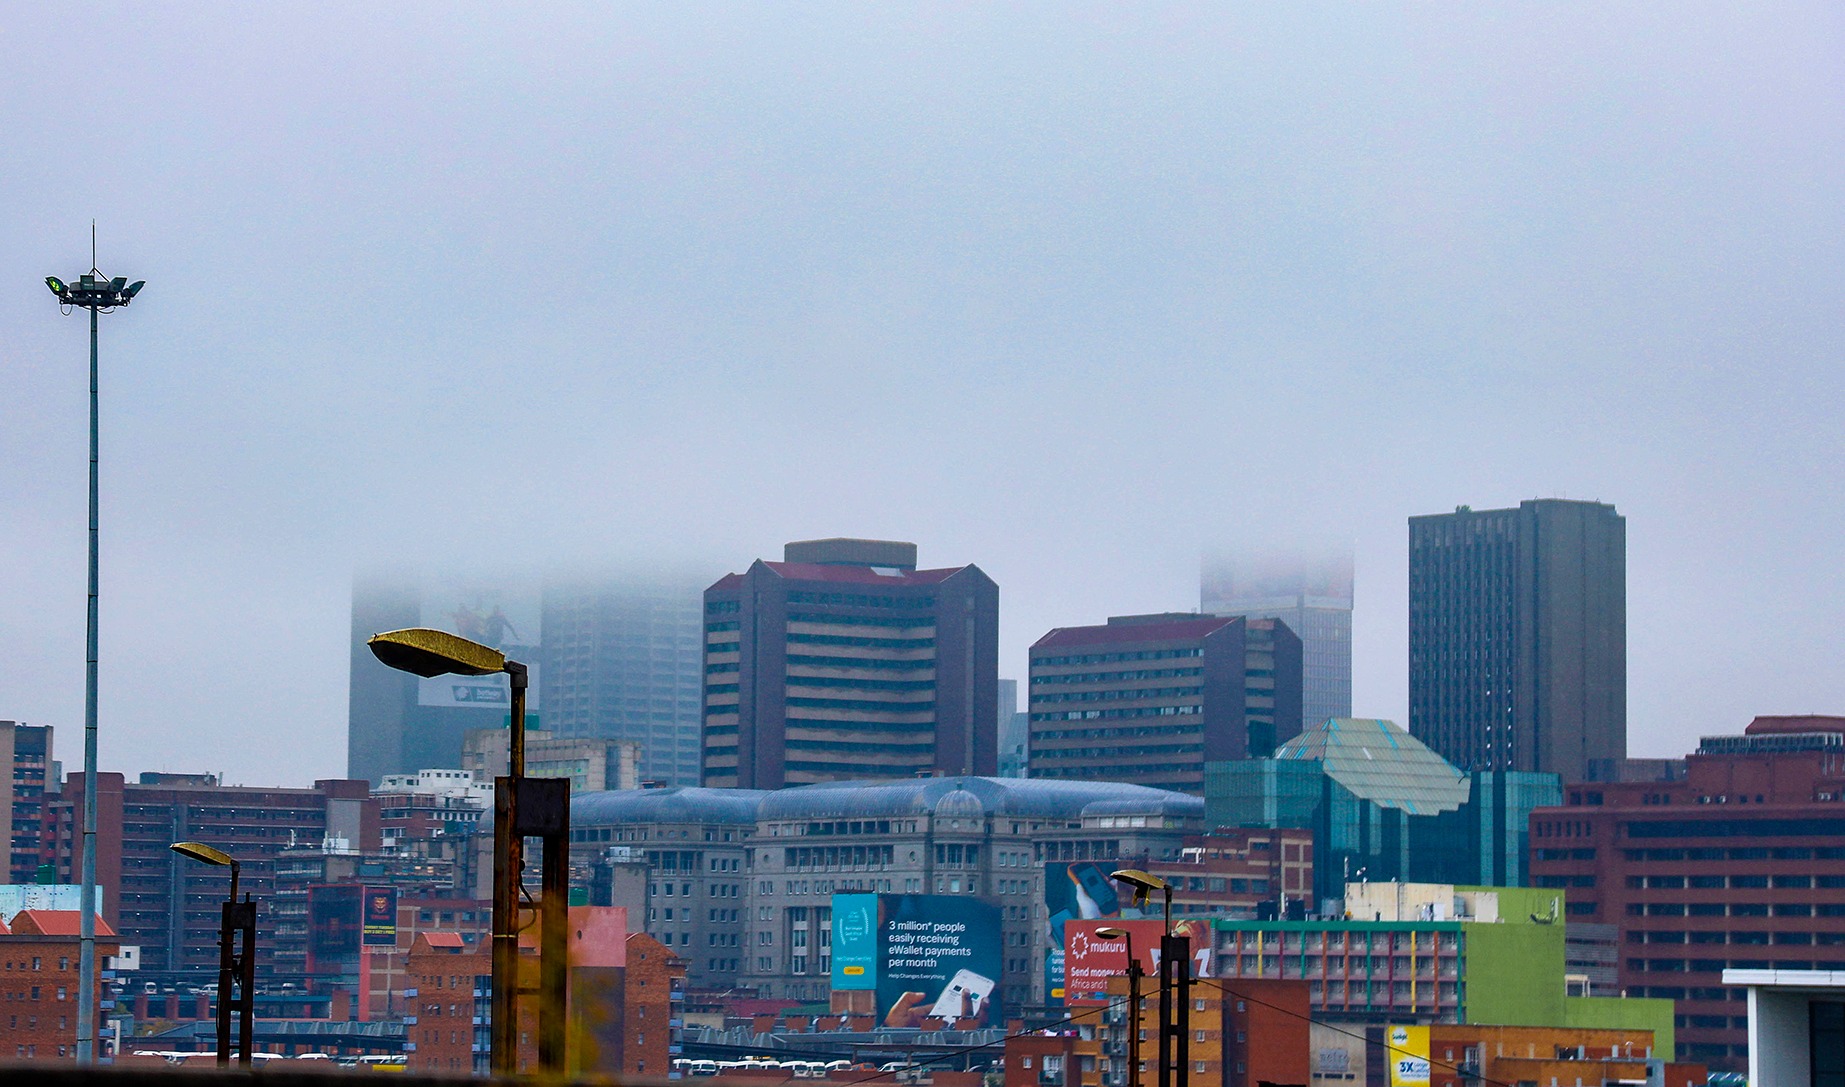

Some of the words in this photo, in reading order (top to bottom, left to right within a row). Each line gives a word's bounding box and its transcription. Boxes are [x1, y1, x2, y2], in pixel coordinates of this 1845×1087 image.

[889, 921, 896, 930] 3
[933, 922, 966, 933] people
[888, 933, 915, 944] easily
[916, 934, 960, 946] receiving
[888, 945, 923, 955] eWallet
[925, 947, 972, 957] payments
[1090, 942, 1126, 953] mukuru
[888, 959, 905, 968] per
[905, 958, 937, 967] month
[1071, 967, 1090, 977] Send
[1090, 969, 1115, 977] money
[1071, 979, 1090, 989] Africa
[1090, 979, 1104, 989] and
[1400, 1061, 1413, 1073] 3X
